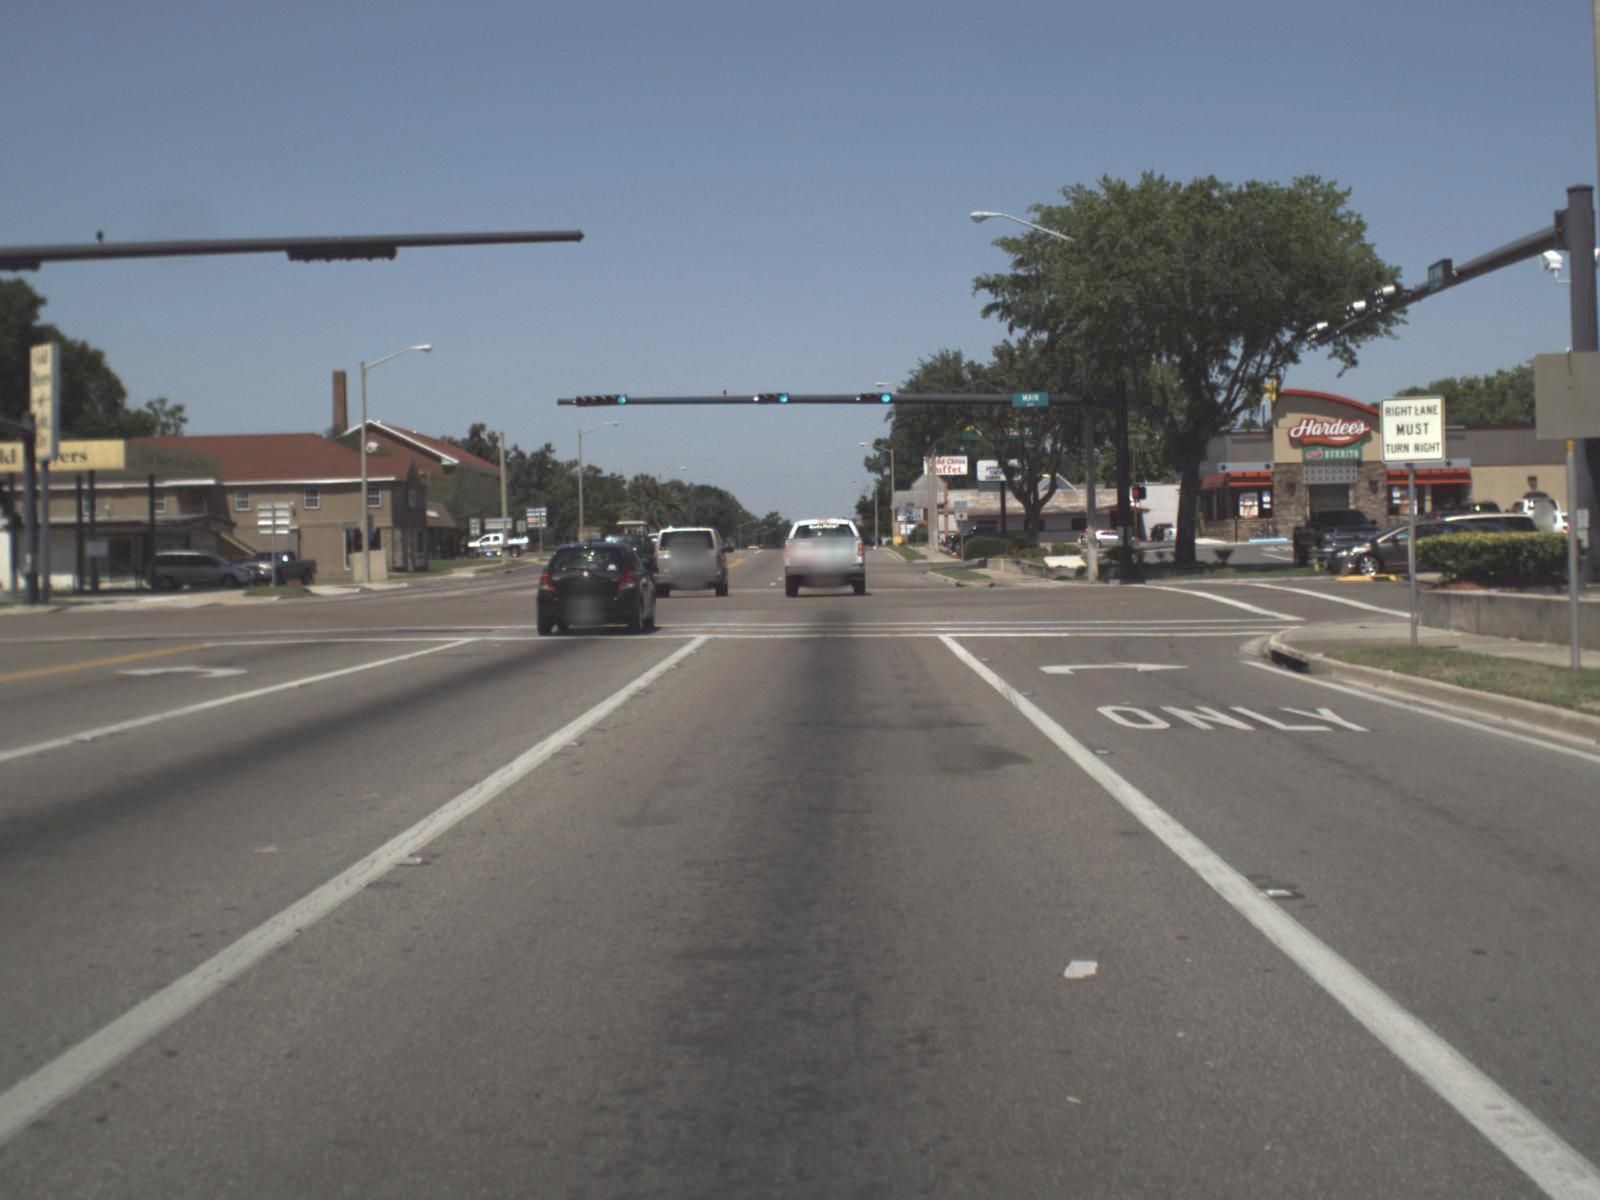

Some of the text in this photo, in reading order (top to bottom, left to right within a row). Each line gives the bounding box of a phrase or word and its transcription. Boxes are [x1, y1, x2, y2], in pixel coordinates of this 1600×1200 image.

[1385, 405, 1439, 417] RIGHT LANE
[1290, 418, 1370, 438] Hardee's
[1396, 422, 1429, 436] MUST
[1386, 442, 1440, 454] TURN RIGHT
[935, 465, 961, 474] uffet
[1096, 704, 1370, 732] ONLY
